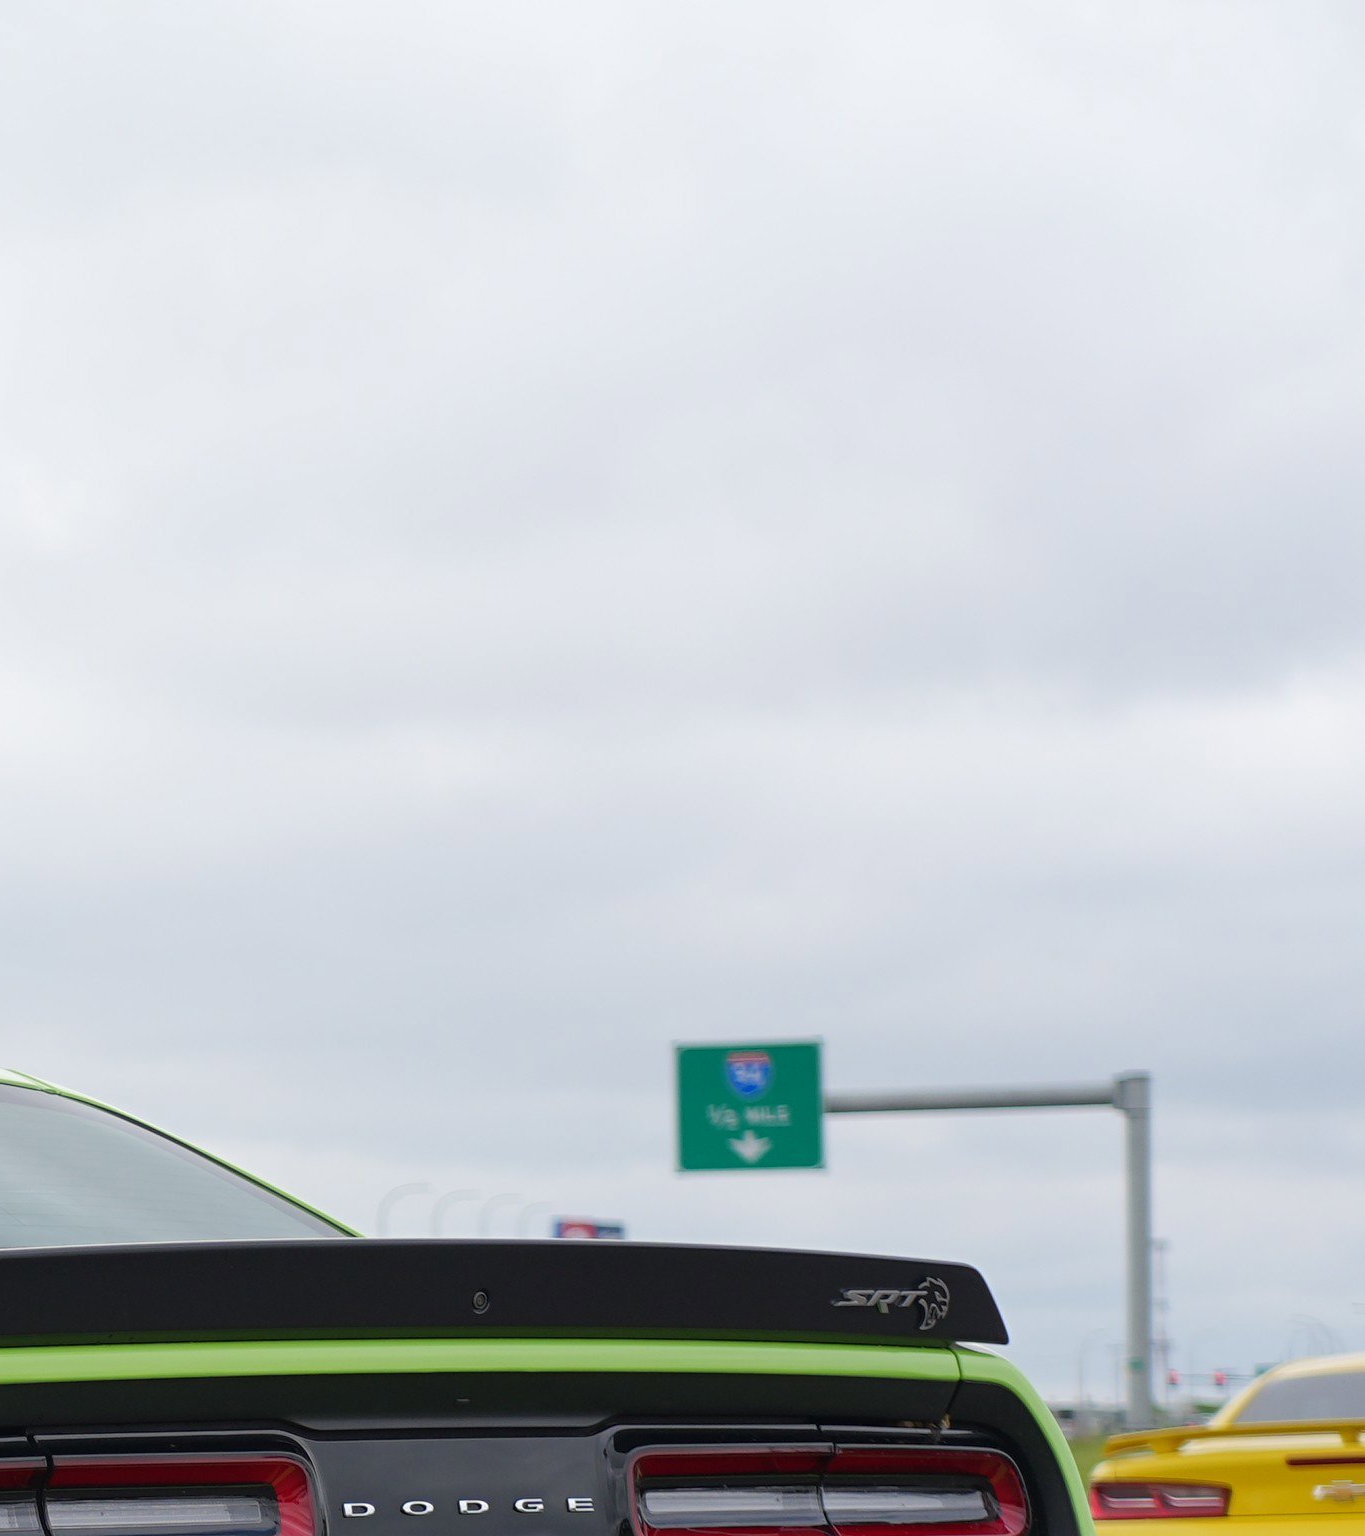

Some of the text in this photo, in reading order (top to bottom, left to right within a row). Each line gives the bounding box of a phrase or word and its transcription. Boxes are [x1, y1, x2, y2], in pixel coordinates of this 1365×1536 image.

[744, 1104, 792, 1127] MILE
[831, 1289, 928, 1314] SRT
[342, 1496, 596, 1519] DODGE
